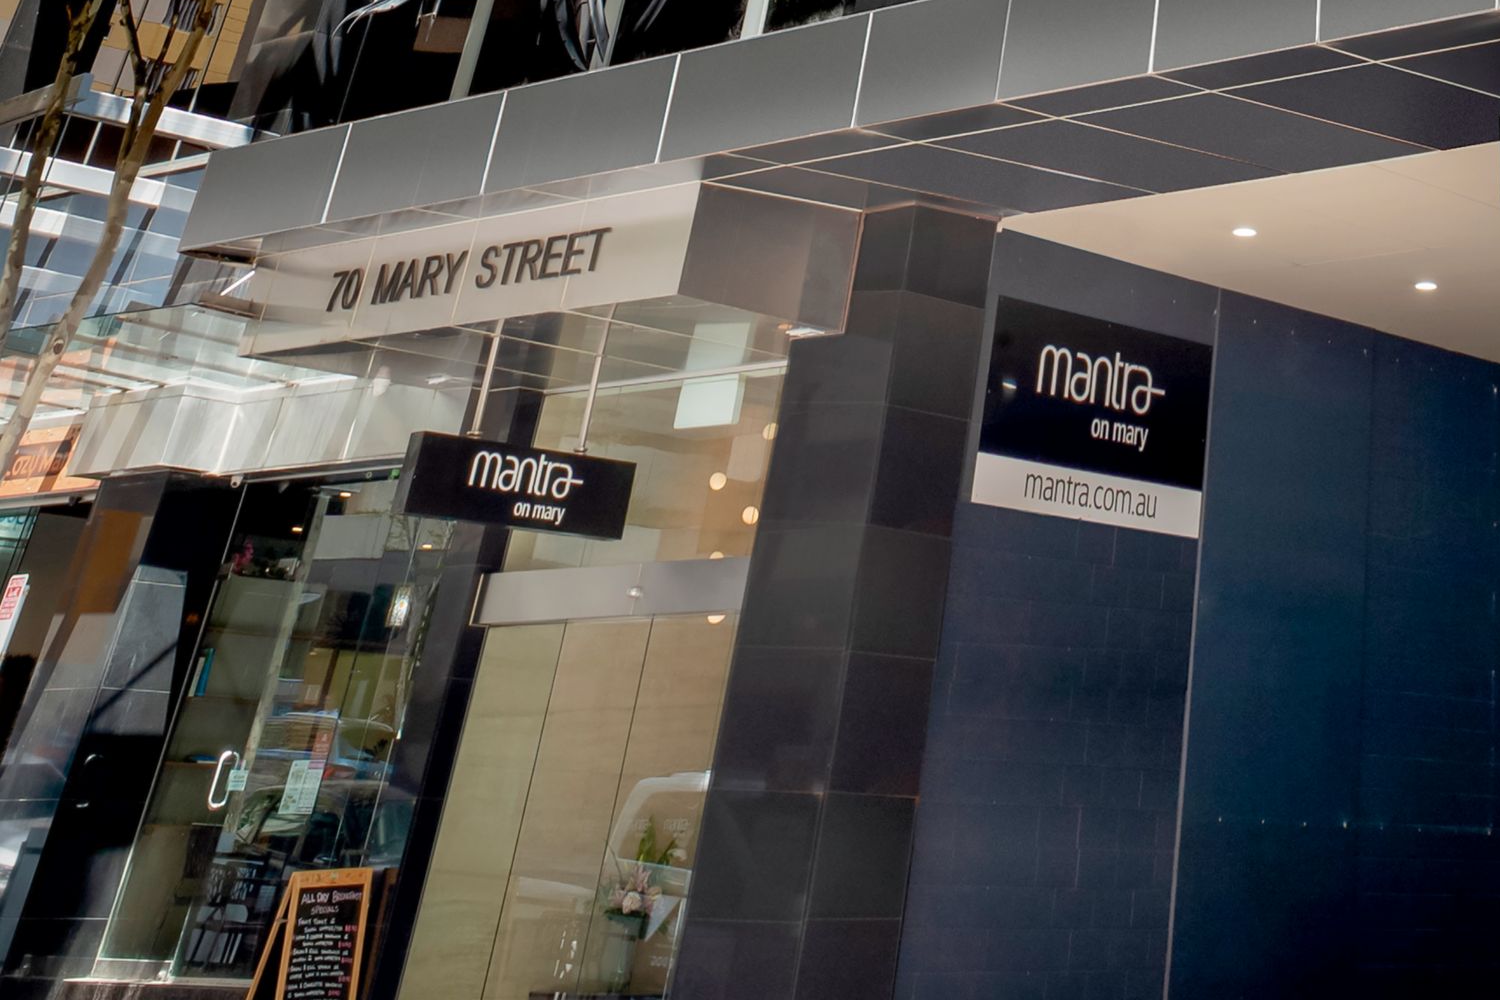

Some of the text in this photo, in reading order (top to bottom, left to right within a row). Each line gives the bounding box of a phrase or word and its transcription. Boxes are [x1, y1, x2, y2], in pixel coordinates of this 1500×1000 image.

[326, 226, 613, 312] 70 MARY STREET
[1036, 344, 1166, 415] mantra
[1091, 418, 1149, 452] on mary
[467, 450, 584, 499] mantra
[1024, 472, 1157, 519] mantra.com.au
[513, 502, 566, 526] on mary
